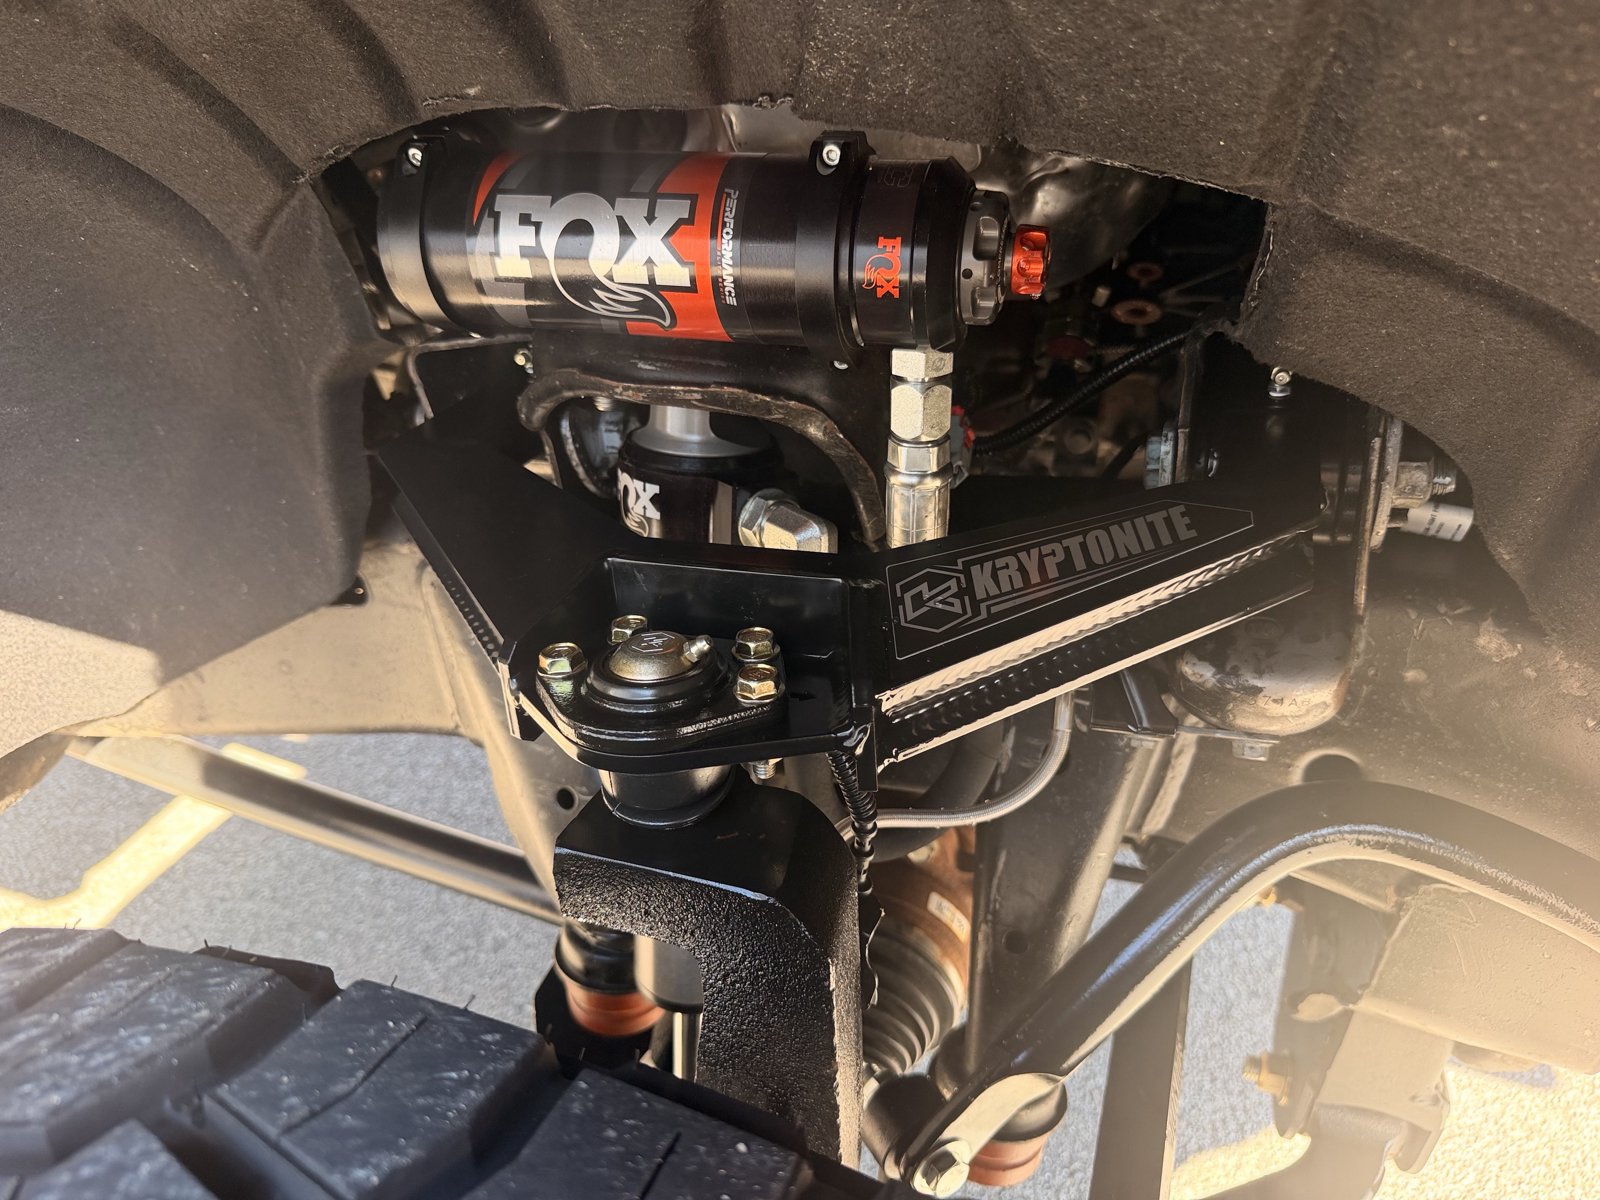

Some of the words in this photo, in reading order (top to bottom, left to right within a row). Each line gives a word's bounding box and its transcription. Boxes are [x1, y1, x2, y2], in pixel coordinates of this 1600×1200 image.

[494, 192, 691, 327] FOX
[721, 188, 739, 306] PERFORMANCE
[862, 235, 902, 299] FOX
[969, 504, 1198, 600] KRYPTONITE
